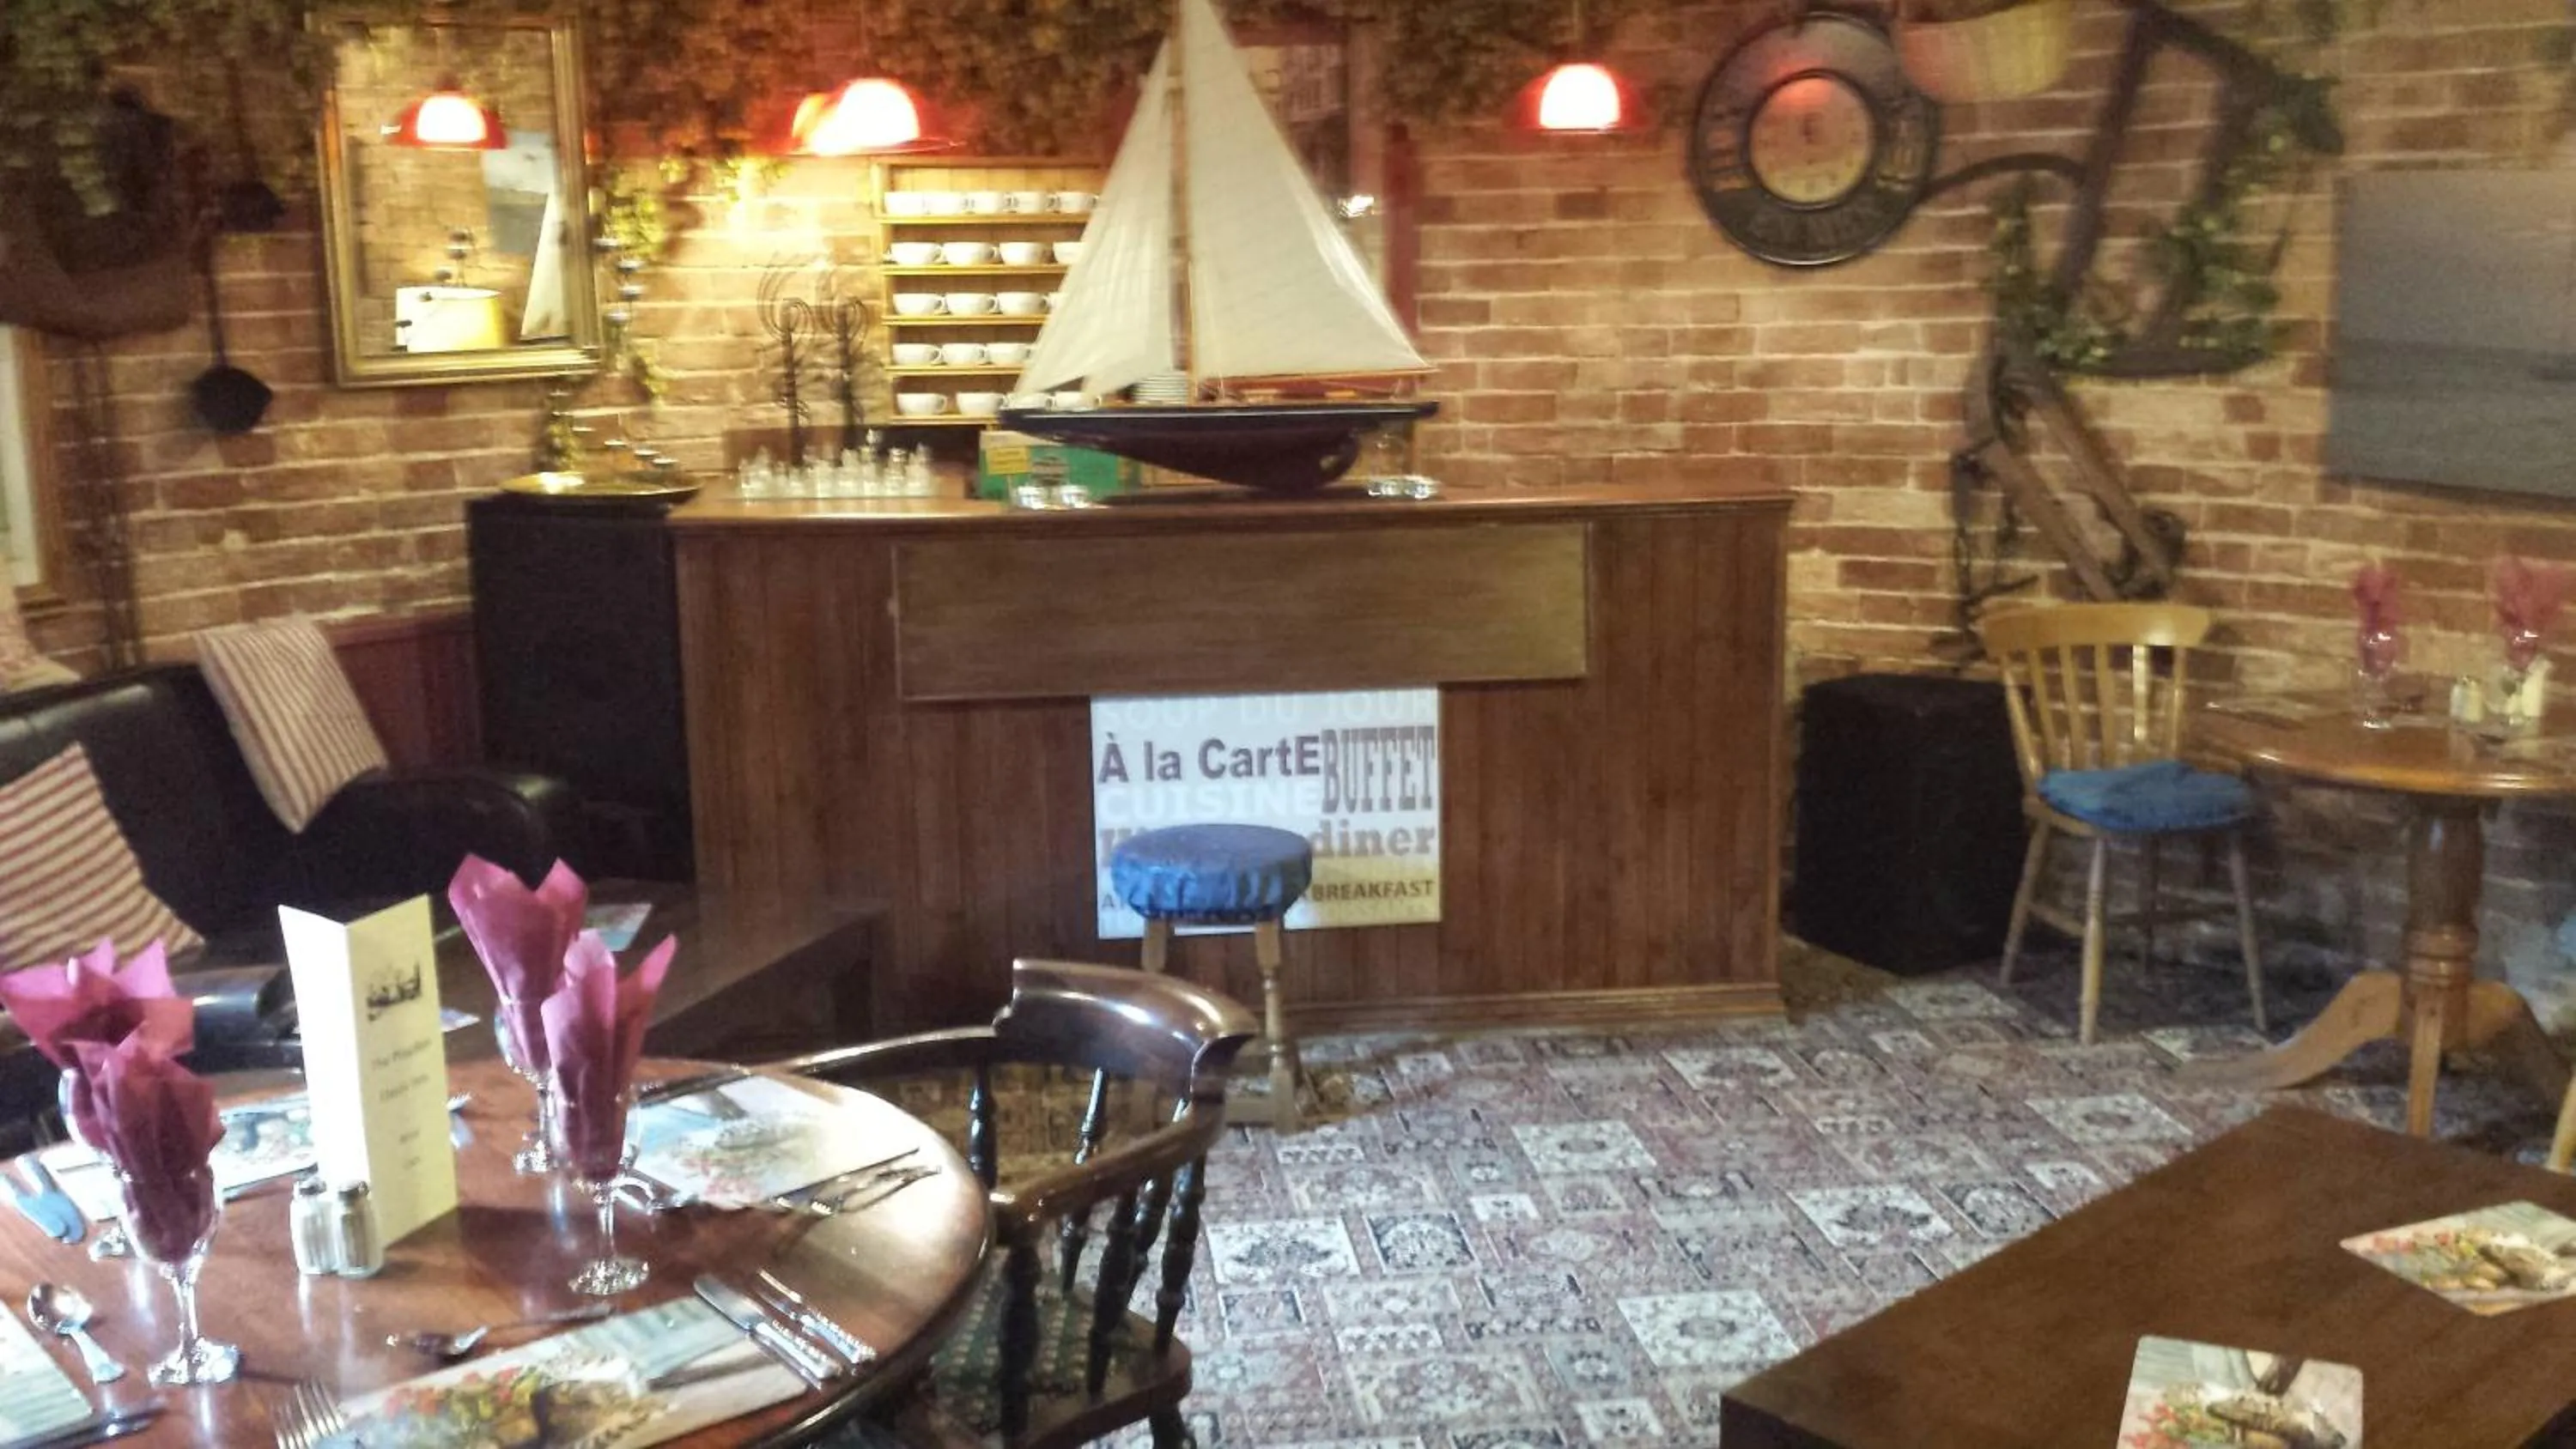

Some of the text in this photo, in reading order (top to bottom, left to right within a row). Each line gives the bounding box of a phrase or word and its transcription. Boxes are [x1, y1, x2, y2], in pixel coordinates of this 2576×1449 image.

[1098, 732, 1320, 783] À la CartE
[1321, 726, 1435, 814] BUFFET
[1097, 782, 1321, 822] CUISINE
[1310, 819, 1435, 858] diner
[1311, 880, 1435, 902] BREAKFAST
